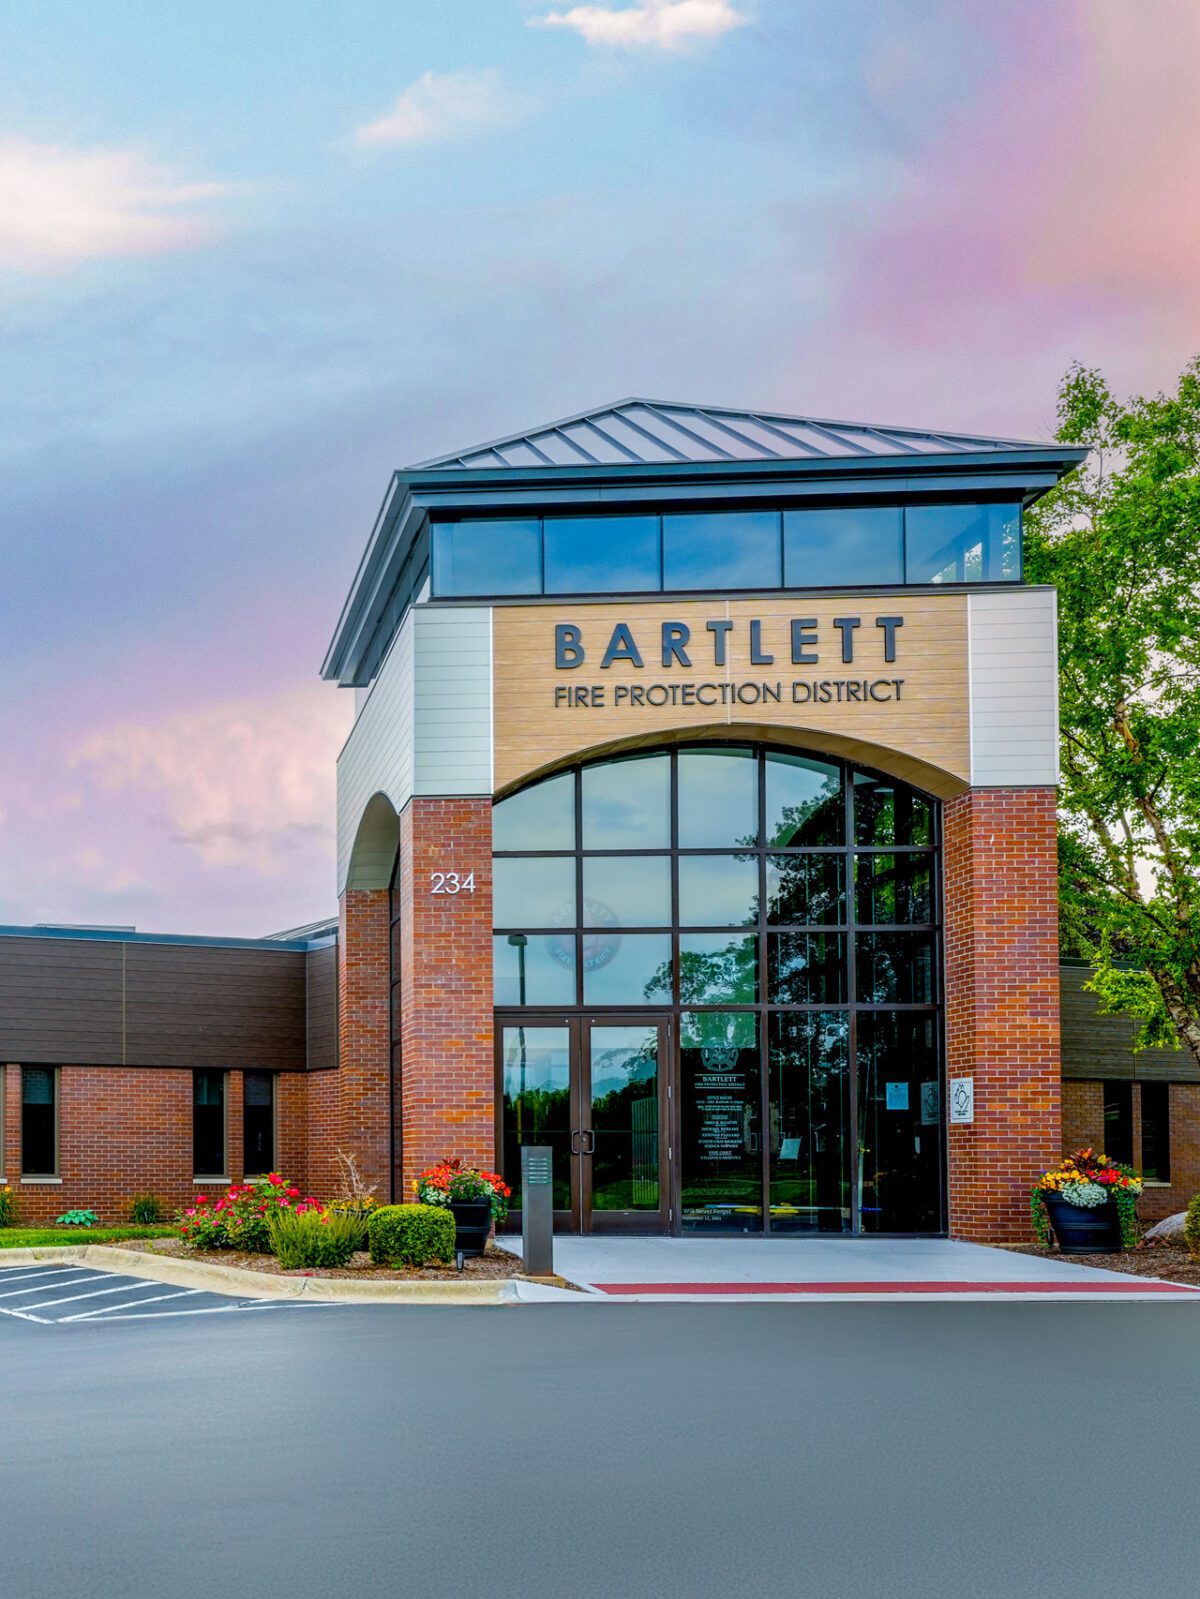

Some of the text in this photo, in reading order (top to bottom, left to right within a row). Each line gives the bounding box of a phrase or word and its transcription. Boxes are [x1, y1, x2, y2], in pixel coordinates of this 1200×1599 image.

[555, 616, 904, 669] BARTLETT
[555, 679, 905, 708] FIRE PROTECTION DISTRICT
[430, 872, 476, 894] 234
